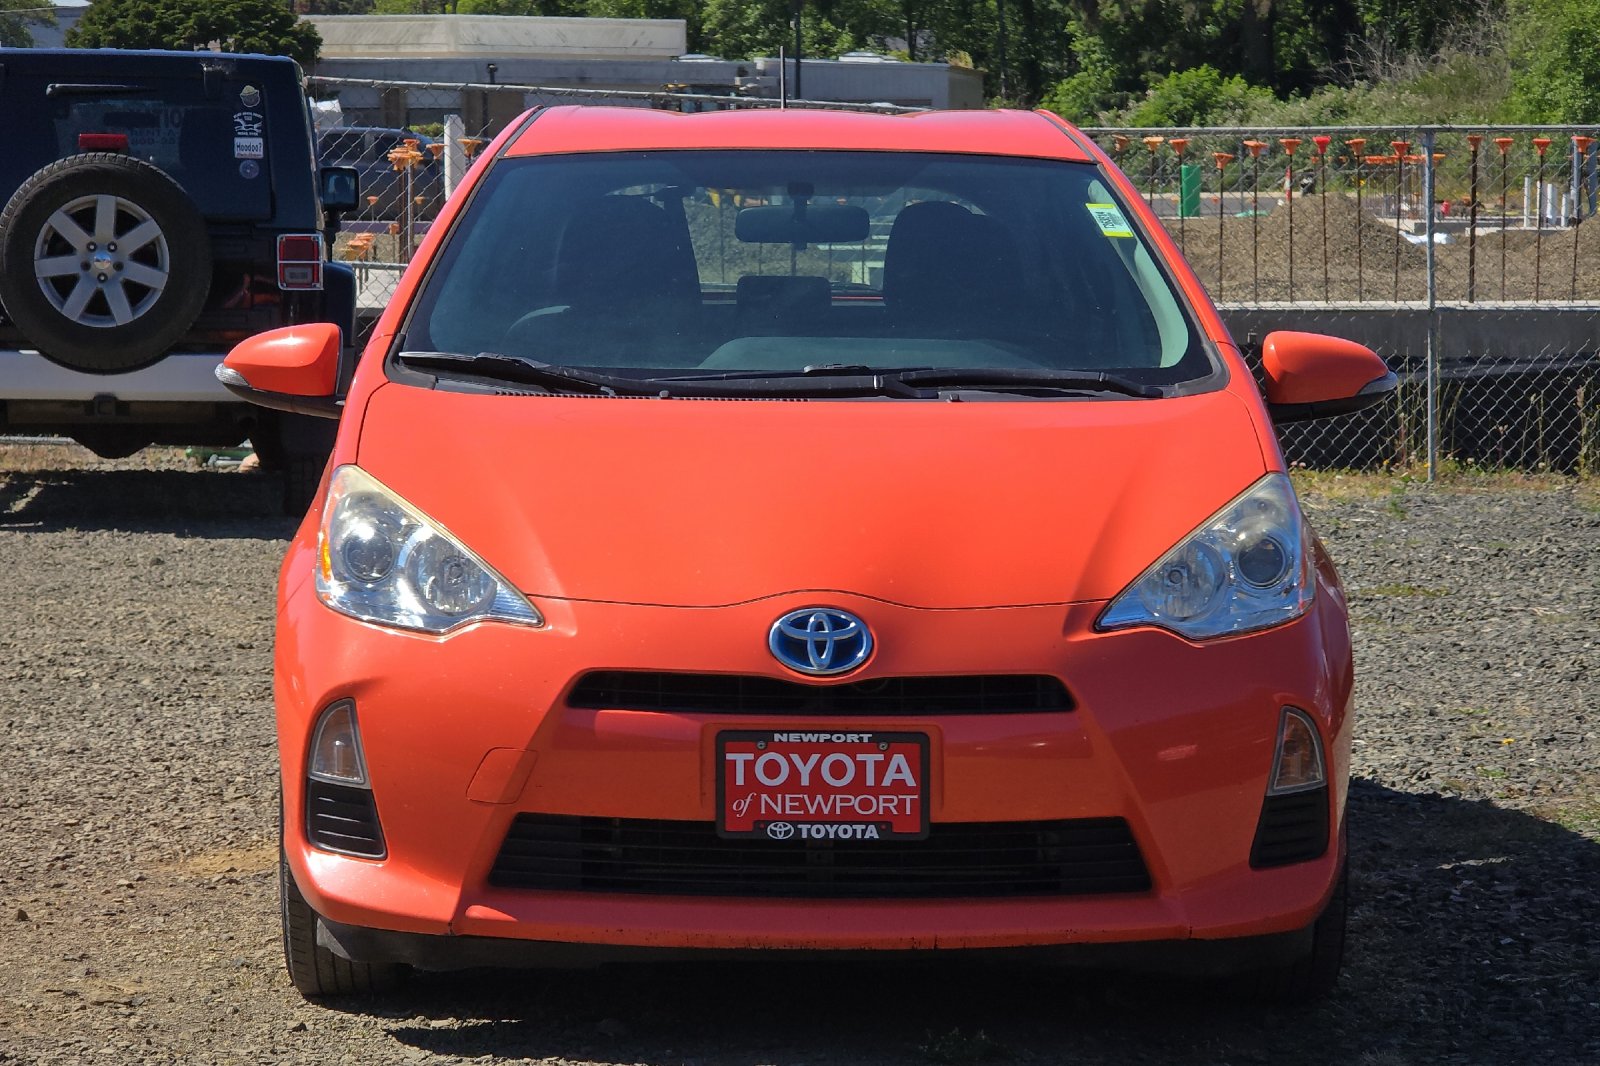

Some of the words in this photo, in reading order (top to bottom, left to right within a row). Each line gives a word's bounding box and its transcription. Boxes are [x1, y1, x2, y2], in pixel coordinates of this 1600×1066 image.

[236, 142, 262, 152] Hoodoo?
[773, 733, 872, 743] NEWPORT
[725, 752, 917, 787] TOYOTA
[732, 792, 757, 818] of
[760, 793, 918, 815] NEWPORT
[797, 824, 879, 839] TOYOTA
